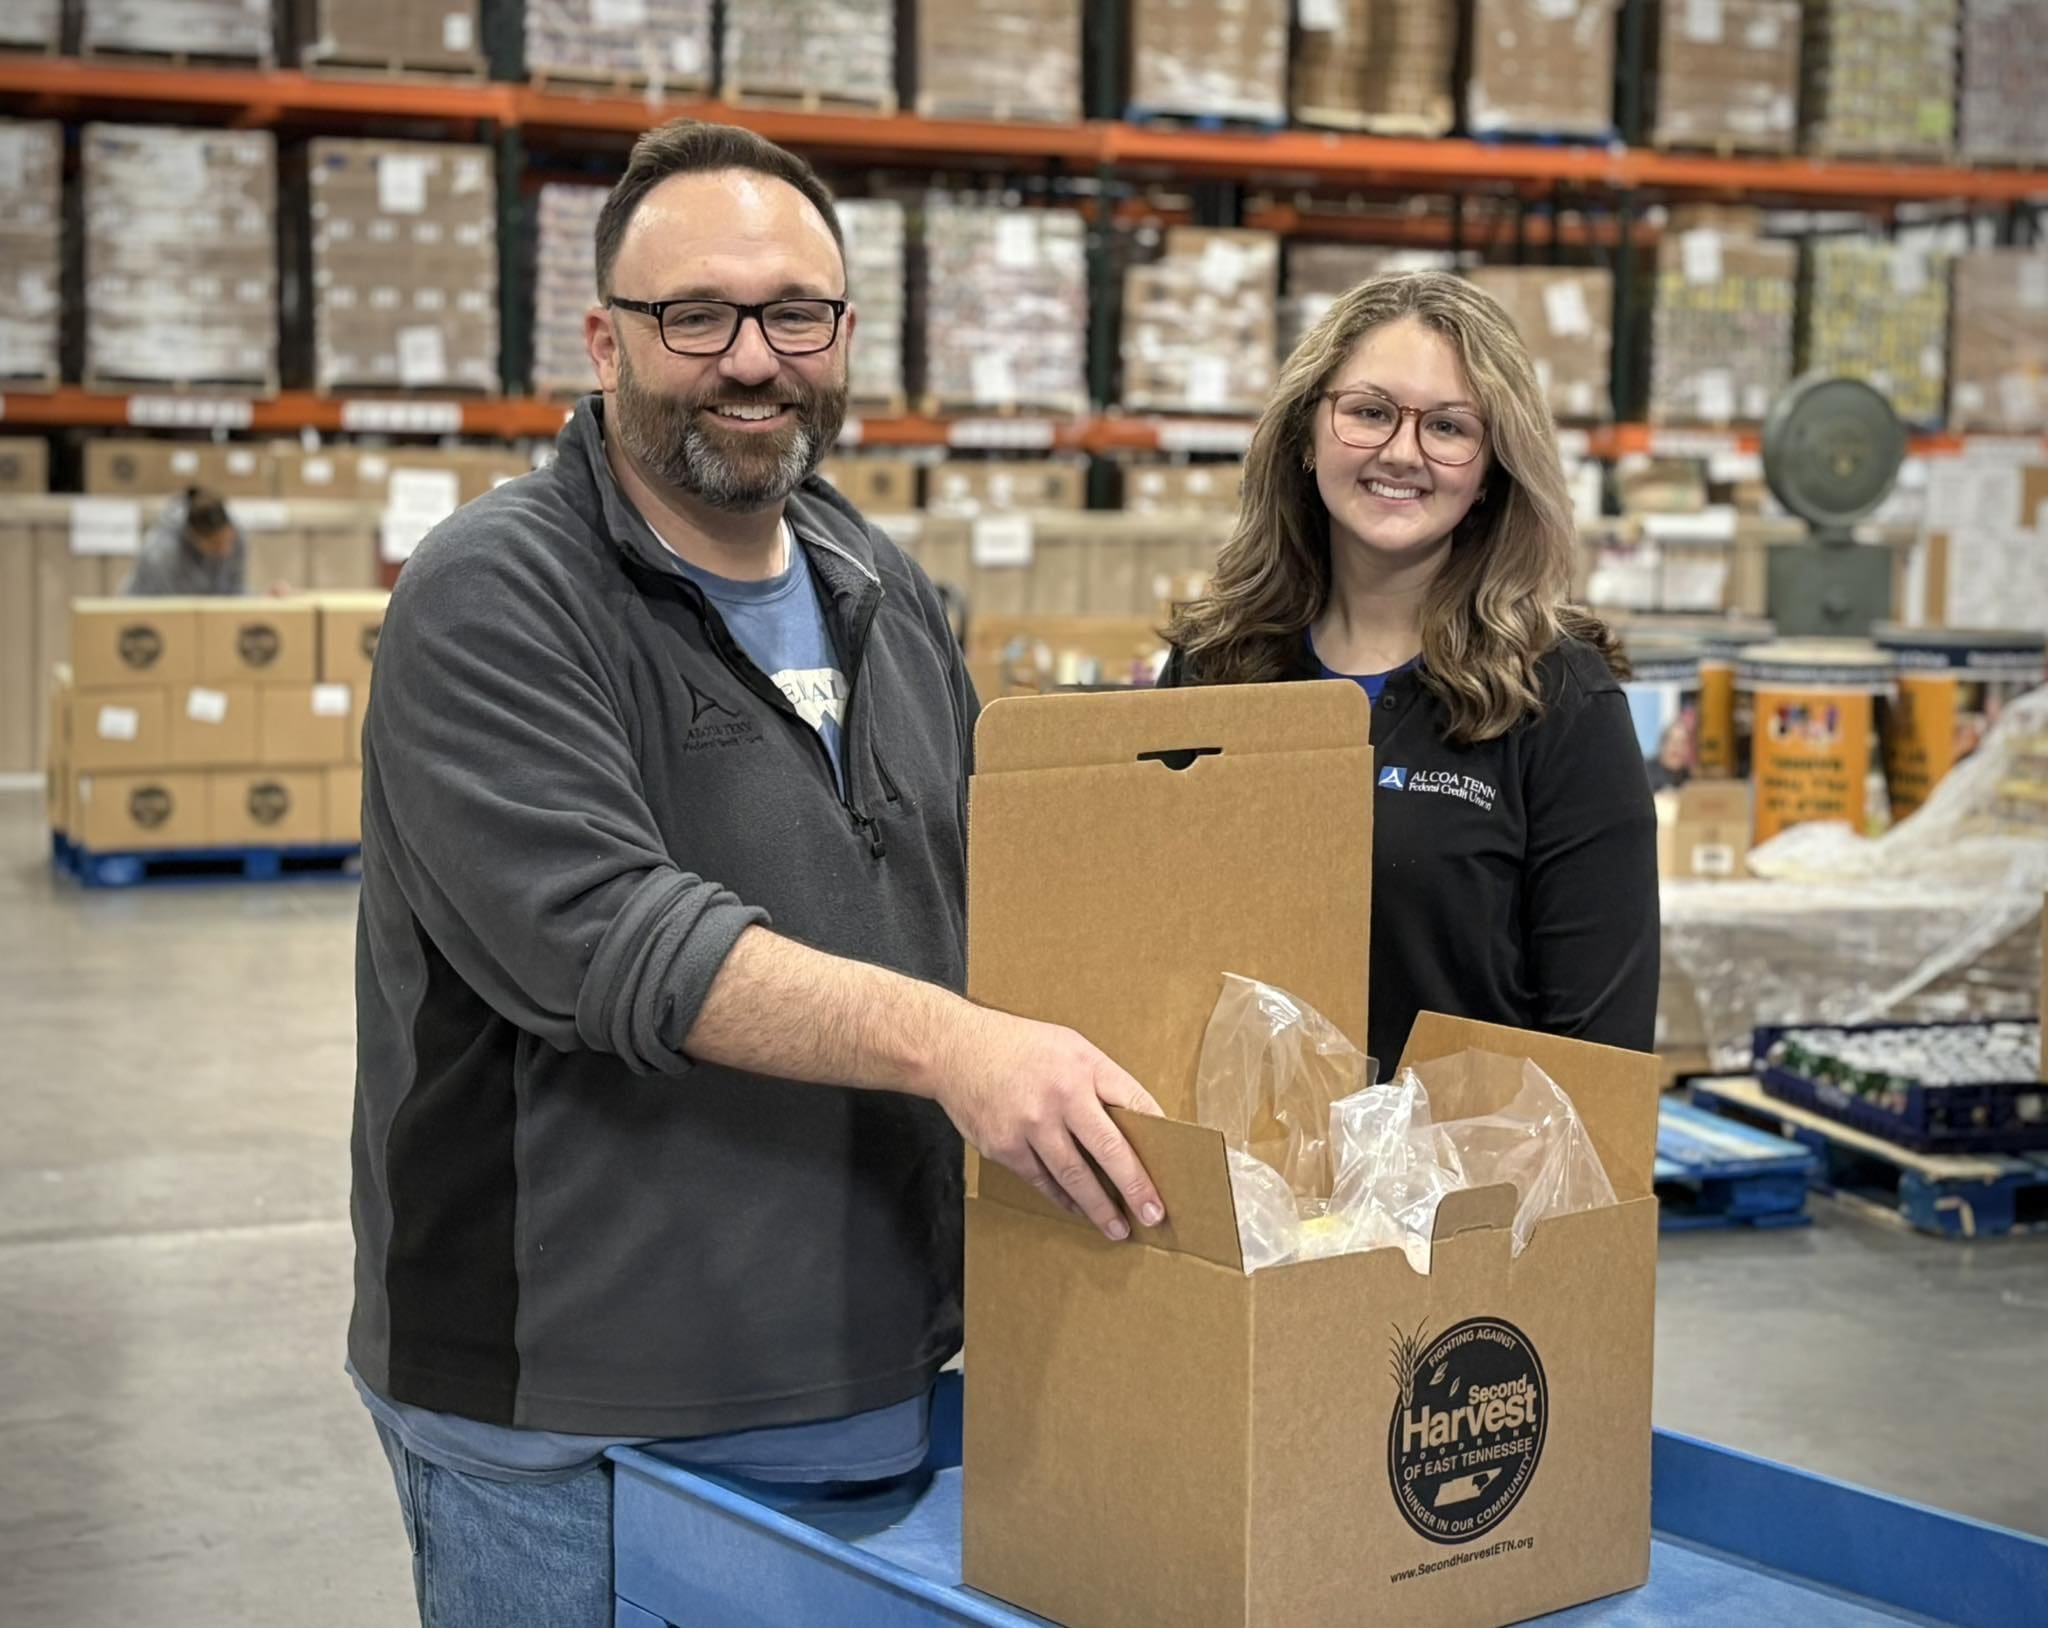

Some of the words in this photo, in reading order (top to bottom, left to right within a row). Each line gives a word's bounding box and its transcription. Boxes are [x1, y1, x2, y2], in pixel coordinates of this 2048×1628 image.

[1408, 782, 1440, 793] Federal
[1440, 784, 1468, 799] Credit
[1468, 792, 1493, 811] Union
[1410, 770, 1460, 786] ALCOA
[1462, 775, 1497, 800] TENN
[1428, 1329, 1475, 1368] FIGHTING
[1475, 1328, 1517, 1351] AGAINST
[1468, 1373, 1528, 1405] Second
[1402, 1384, 1538, 1453] Harvest
[1403, 1464, 1421, 1481] OF
[1424, 1455, 1458, 1476] EAST
[1461, 1437, 1533, 1467] TENNESSEE
[1402, 1482, 1438, 1527] HUNGER
[1436, 1519, 1449, 1532] IN
[1450, 1518, 1474, 1532] OUR
[1476, 1452, 1532, 1524] COMMUNITY
[1389, 1536, 1535, 1584] www.SecondHarvestETN.org
